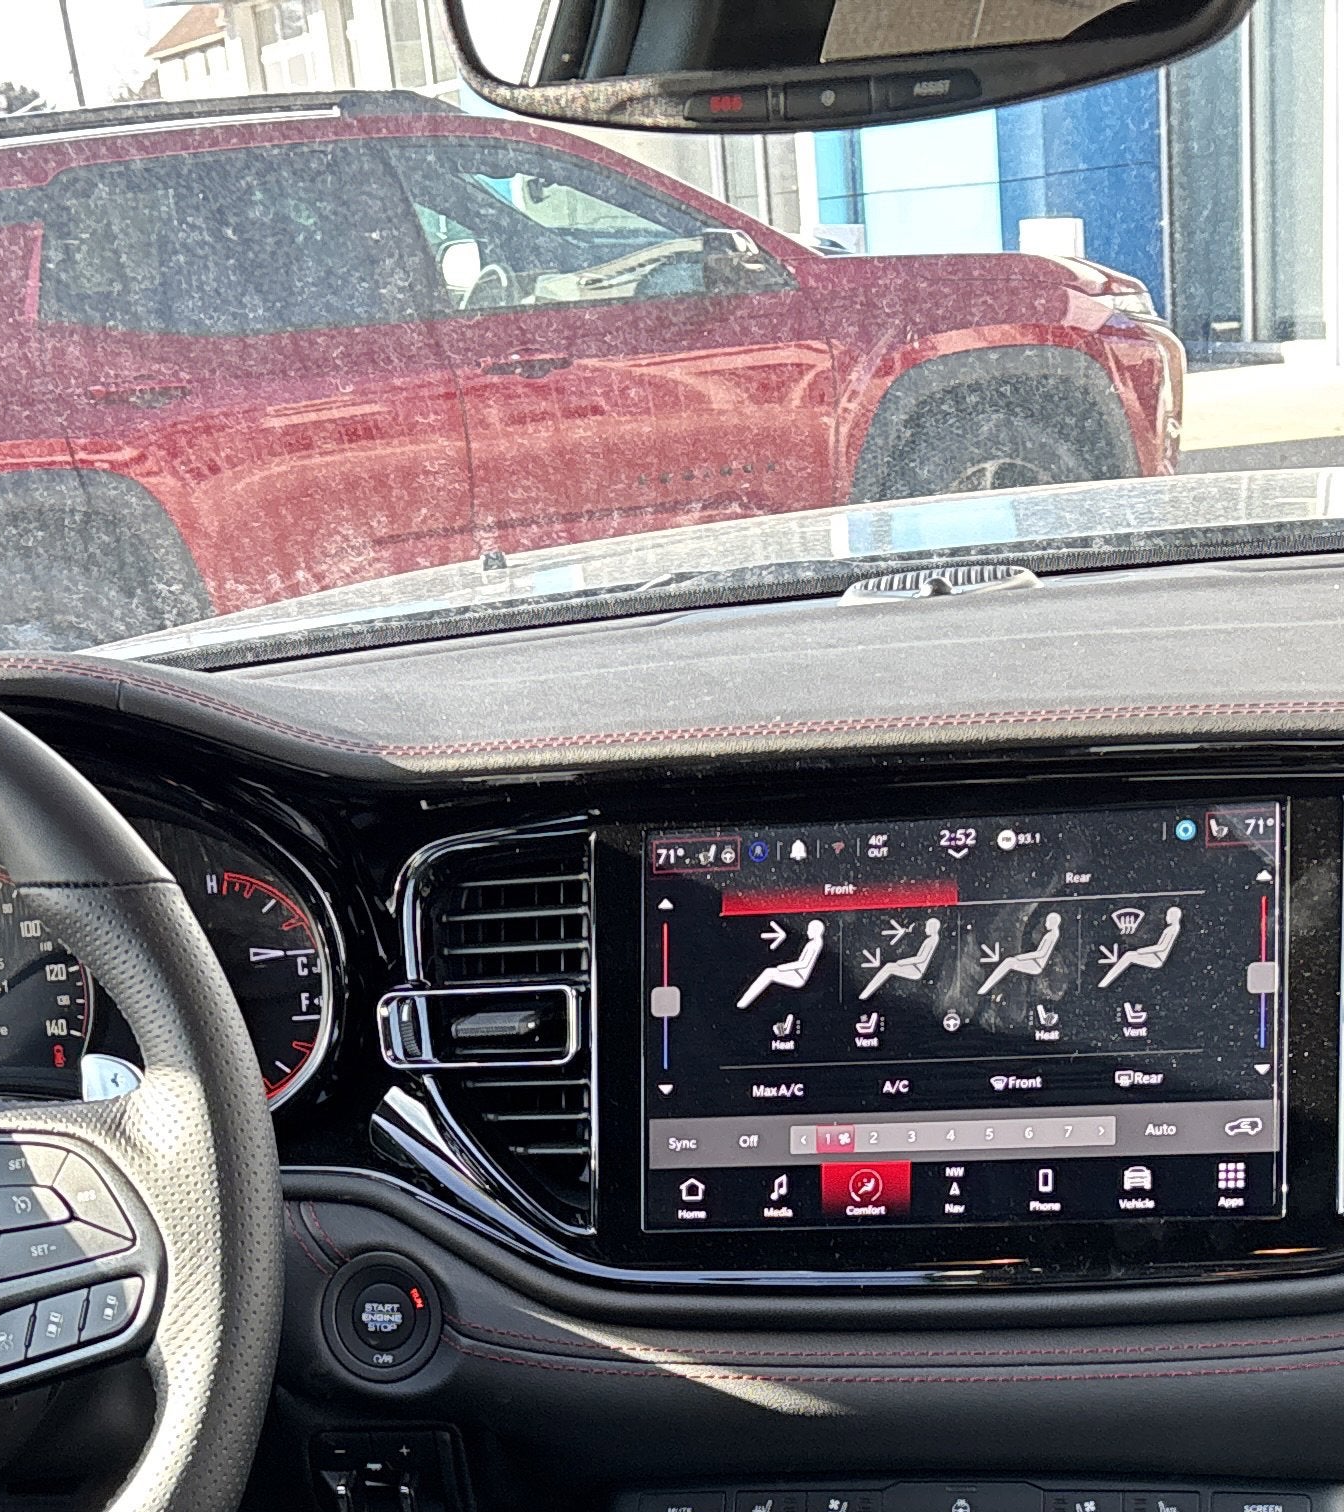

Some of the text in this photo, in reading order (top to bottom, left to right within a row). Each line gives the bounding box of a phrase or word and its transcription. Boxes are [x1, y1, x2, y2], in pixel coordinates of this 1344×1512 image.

[940, 829, 977, 846] 2:52
[1017, 833, 1041, 844] 93.1
[868, 847, 888, 858] OUT
[206, 873, 218, 895] H
[1065, 872, 1092, 884] Rear
[824, 883, 854, 896] Front
[19, 919, 42, 938] 100
[297, 956, 309, 976] C
[45, 963, 67, 982] 120
[300, 992, 310, 1012] F
[45, 1019, 68, 1036] 140
[1123, 1026, 1148, 1038] Vent
[1035, 1029, 1060, 1041] Heat
[771, 1040, 795, 1051] Heat
[855, 1036, 879, 1048] Vent
[1008, 1075, 1043, 1089] Front
[1133, 1072, 1164, 1085] Rear
[882, 1080, 910, 1094] A/C
[946, 1129, 956, 1142] 4
[984, 1128, 994, 1140] 5
[1024, 1126, 1034, 1139] 6
[1063, 1126, 1073, 1138] 7
[1144, 1123, 1177, 1137] Auto
[739, 1134, 760, 1148] Off
[824, 1133, 831, 1145] 1
[869, 1132, 878, 1144] 2
[907, 1130, 916, 1143] 3
[668, 1137, 698, 1152] Sync
[945, 1166, 965, 1178] NW
[1029, 1200, 1062, 1212] Phone
[1118, 1198, 1155, 1210] Vehicle
[1217, 1195, 1244, 1208] Apps
[677, 1208, 707, 1220] Home
[763, 1206, 793, 1218] Media
[846, 1204, 887, 1217] Comfort
[944, 1203, 965, 1215] Nav
[364, 1302, 401, 1313] START
[361, 1312, 403, 1323] ENGINE
[367, 1323, 398, 1333] STOP
